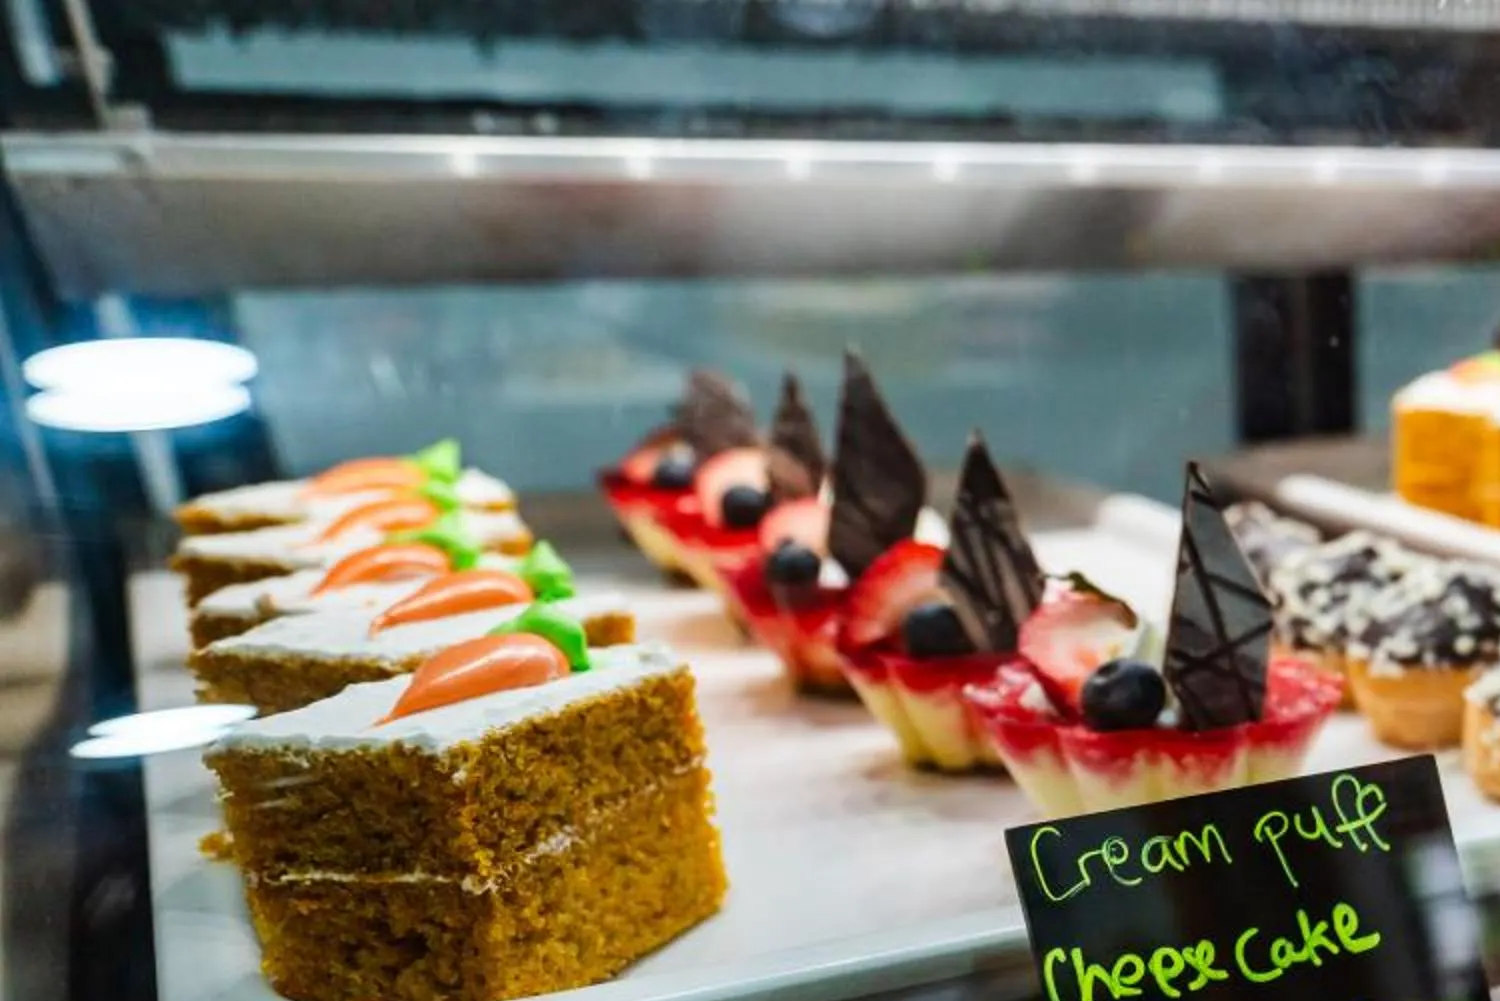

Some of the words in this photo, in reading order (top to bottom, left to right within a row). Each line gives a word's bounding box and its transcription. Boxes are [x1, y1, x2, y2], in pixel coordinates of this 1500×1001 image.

[1031, 824, 1231, 902] Cream
[1254, 774, 1390, 887] puff
[1235, 902, 1381, 982] Cake
